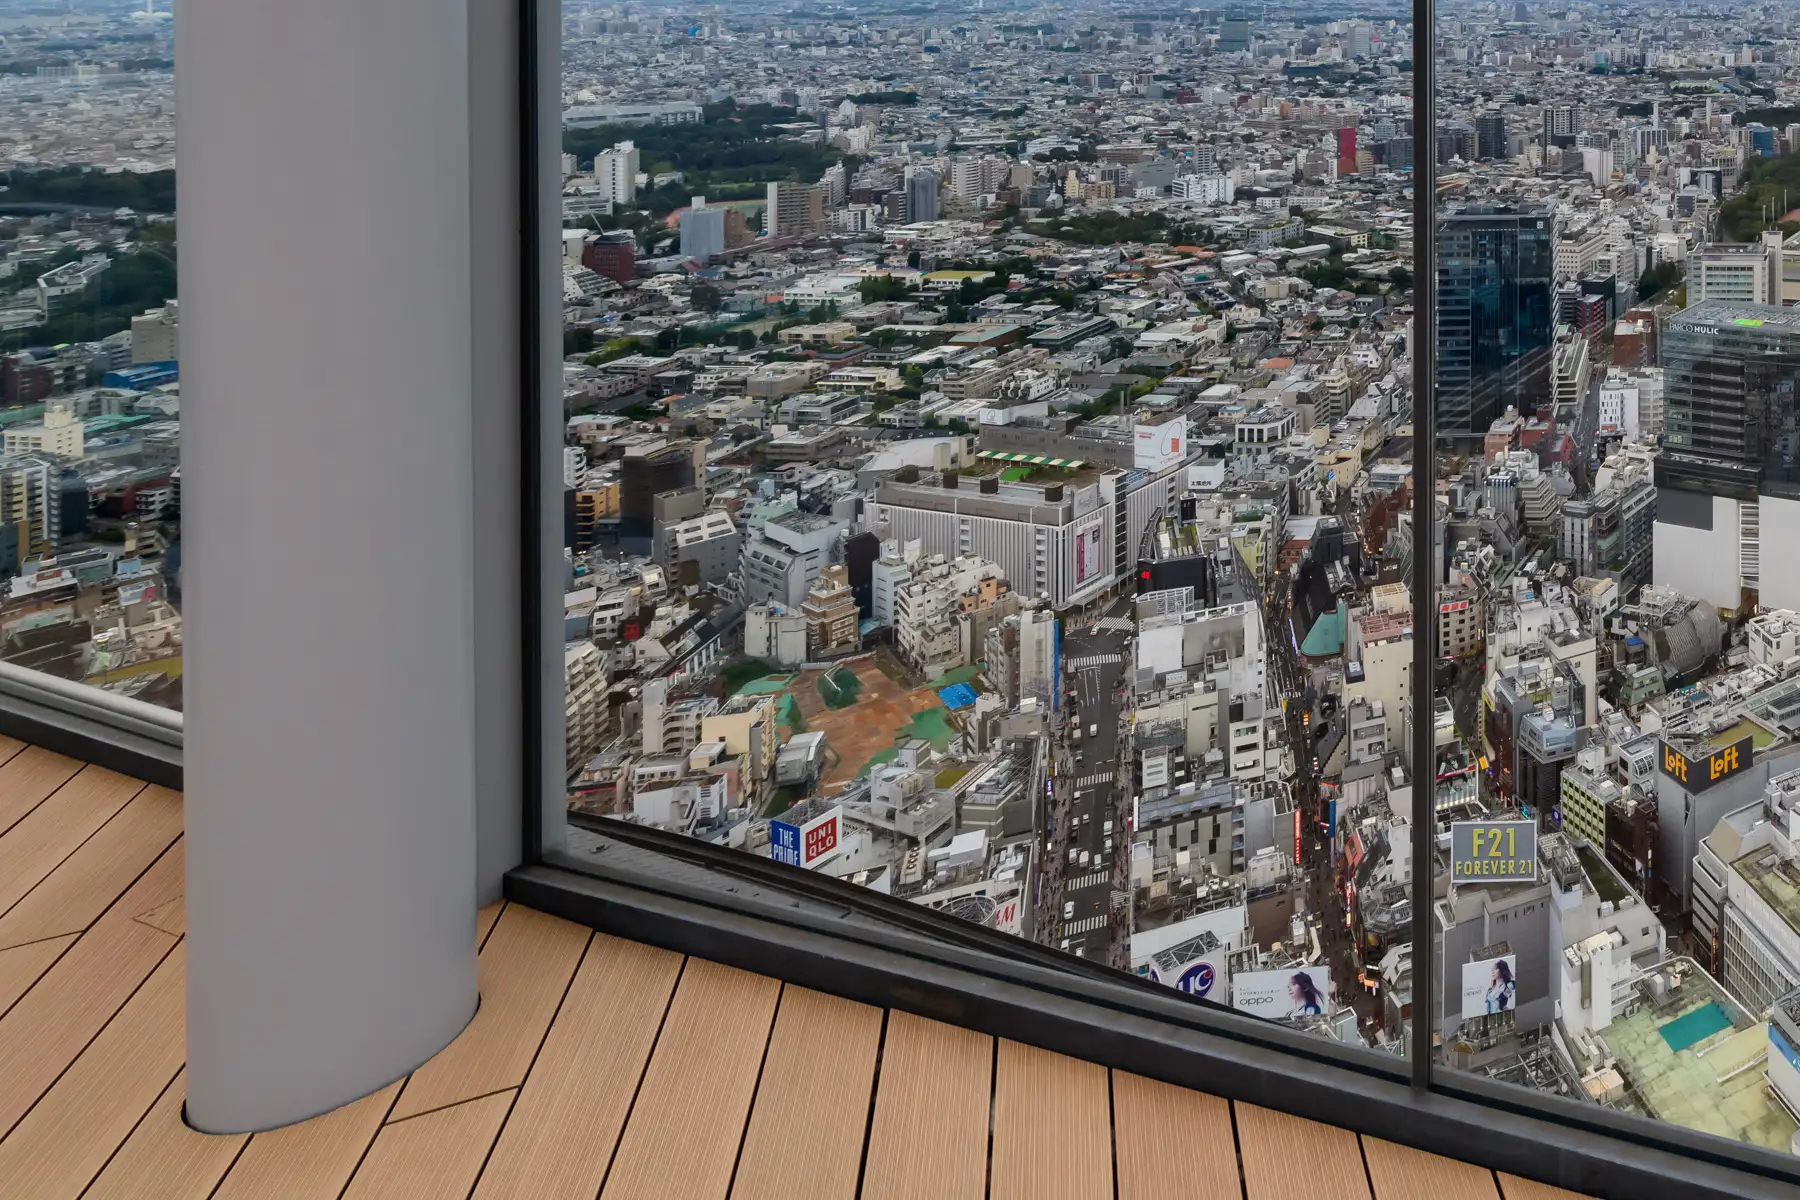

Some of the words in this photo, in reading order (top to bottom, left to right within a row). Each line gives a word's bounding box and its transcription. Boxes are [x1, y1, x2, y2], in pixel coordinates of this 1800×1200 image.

[1694, 325, 1719, 335] HULIC
[778, 827, 794, 849] THE
[808, 823, 832, 844] UNI
[1472, 827, 1515, 857] F21
[809, 835, 834, 857] QLO
[1455, 860, 1515, 876] FOREVER
[1519, 859, 1532, 874] 21
[1239, 996, 1274, 1006] oppo
